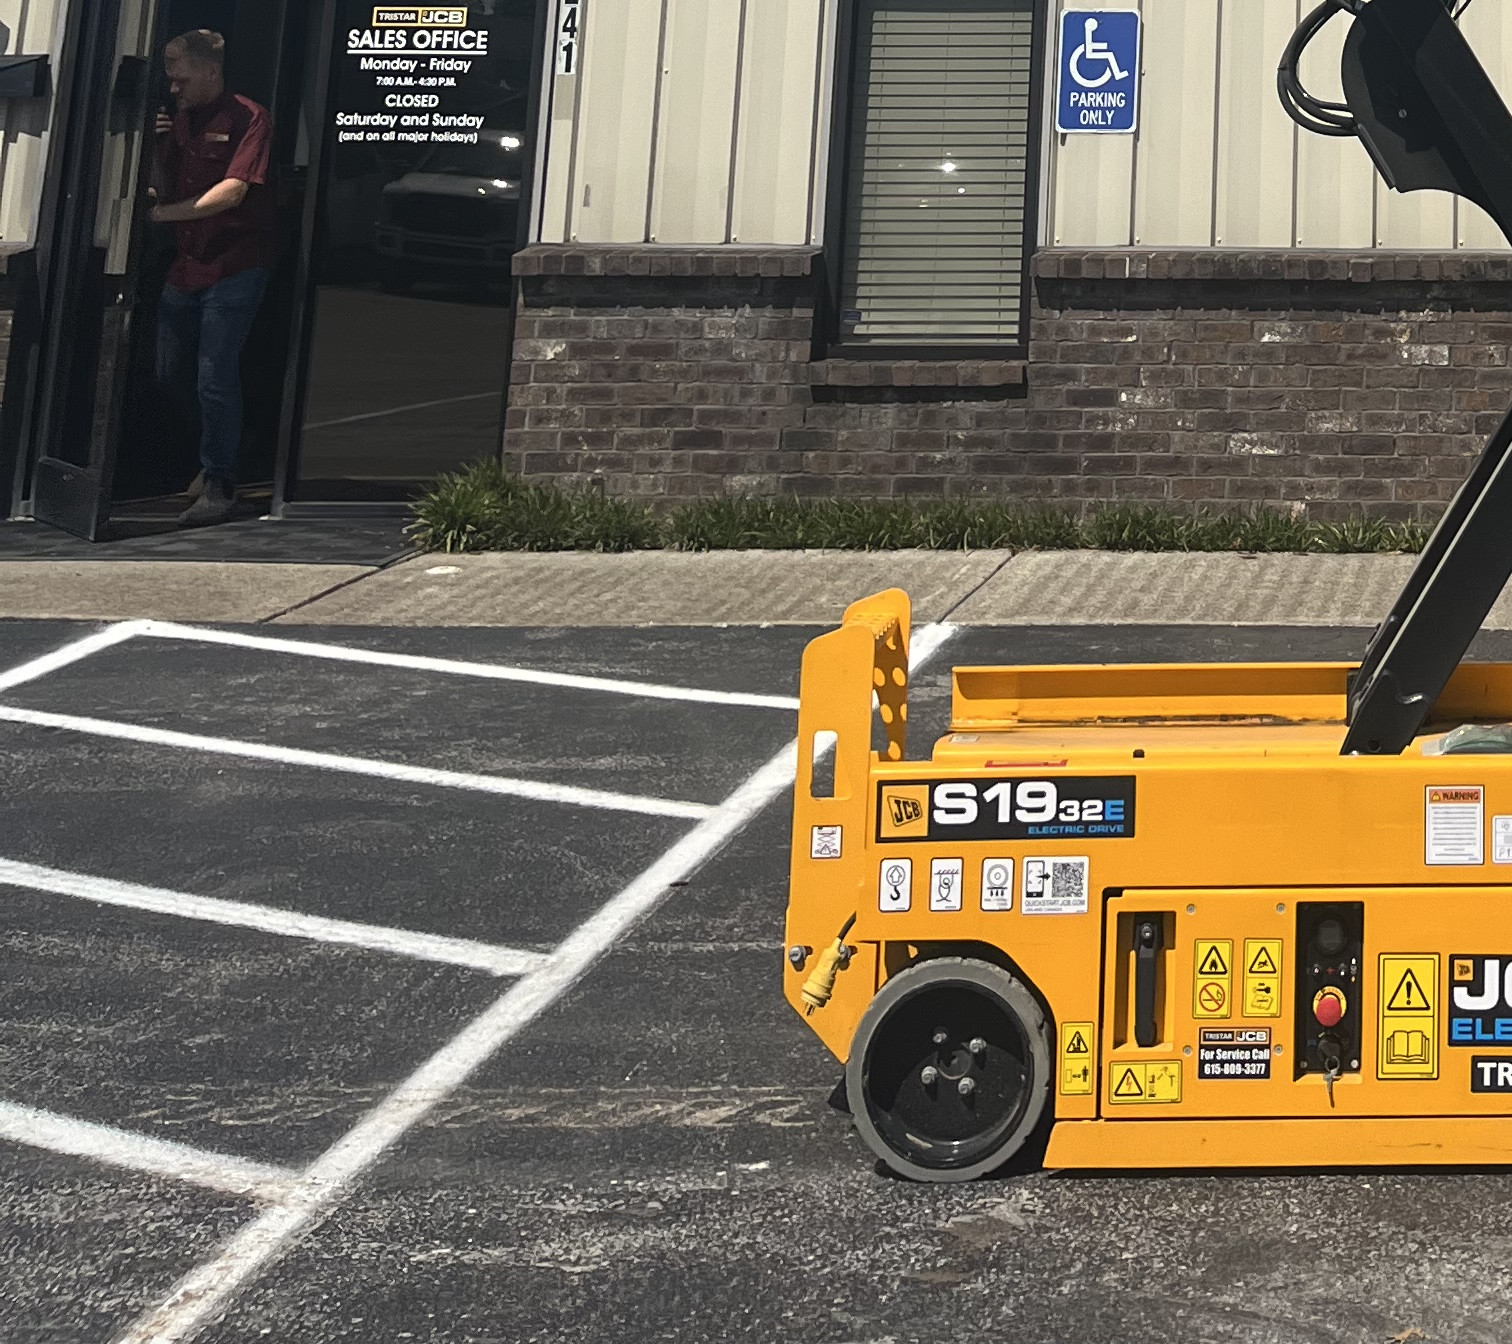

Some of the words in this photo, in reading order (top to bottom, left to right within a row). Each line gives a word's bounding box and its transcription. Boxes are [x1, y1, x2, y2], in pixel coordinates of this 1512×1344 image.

[378, 12, 417, 21] TRISTAR
[421, 10, 463, 23] JCB
[347, 29, 407, 49] SALES
[412, 30, 488, 50] OFFICE
[360, 57, 418, 73] Monday
[429, 58, 472, 74] Friday
[385, 94, 440, 108] CLOSED
[1069, 92, 1126, 108] PARKING
[336, 112, 398, 128] Saturday
[400, 113, 429, 126] and
[432, 113, 485, 129] Sunday
[1080, 110, 1115, 125] ONLY
[338, 131, 364, 143] (and
[366, 133, 380, 141] on
[382, 131, 396, 142] all
[397, 132, 430, 144] major
[431, 131, 478, 145] holidays)
[1442, 791, 1480, 801] WARNING
[893, 798, 921, 823] JCB
[1027, 824, 1085, 834] ELECTRIC
[1088, 824, 1125, 833] DRIVE
[1204, 1032, 1233, 1040] TRISTAR
[1236, 1031, 1267, 1041] JCB
[1200, 1048, 1214, 1060] For
[1216, 1048, 1251, 1060] Service
[1251, 1048, 1270, 1060] Call
